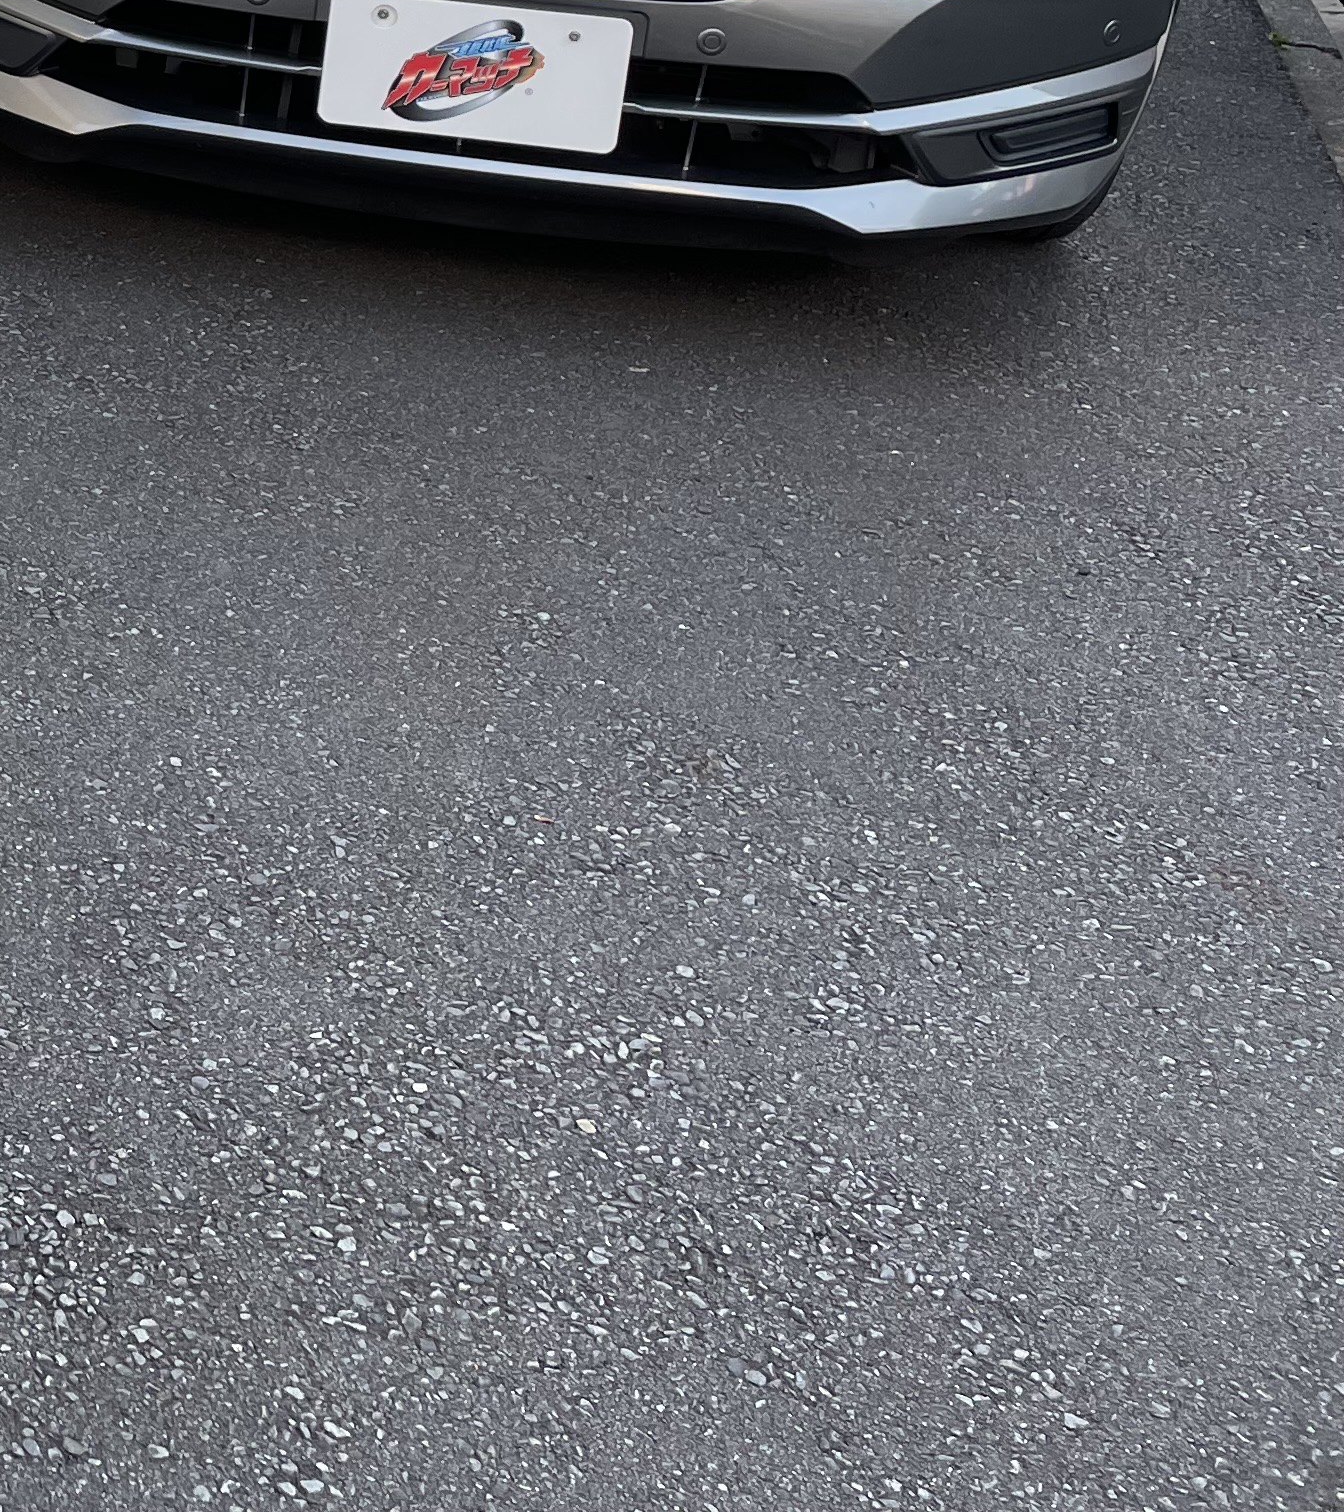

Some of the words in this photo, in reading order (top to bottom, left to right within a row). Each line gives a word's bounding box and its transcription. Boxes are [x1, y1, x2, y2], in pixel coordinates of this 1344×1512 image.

[380, 44, 536, 111] カーマッチ
